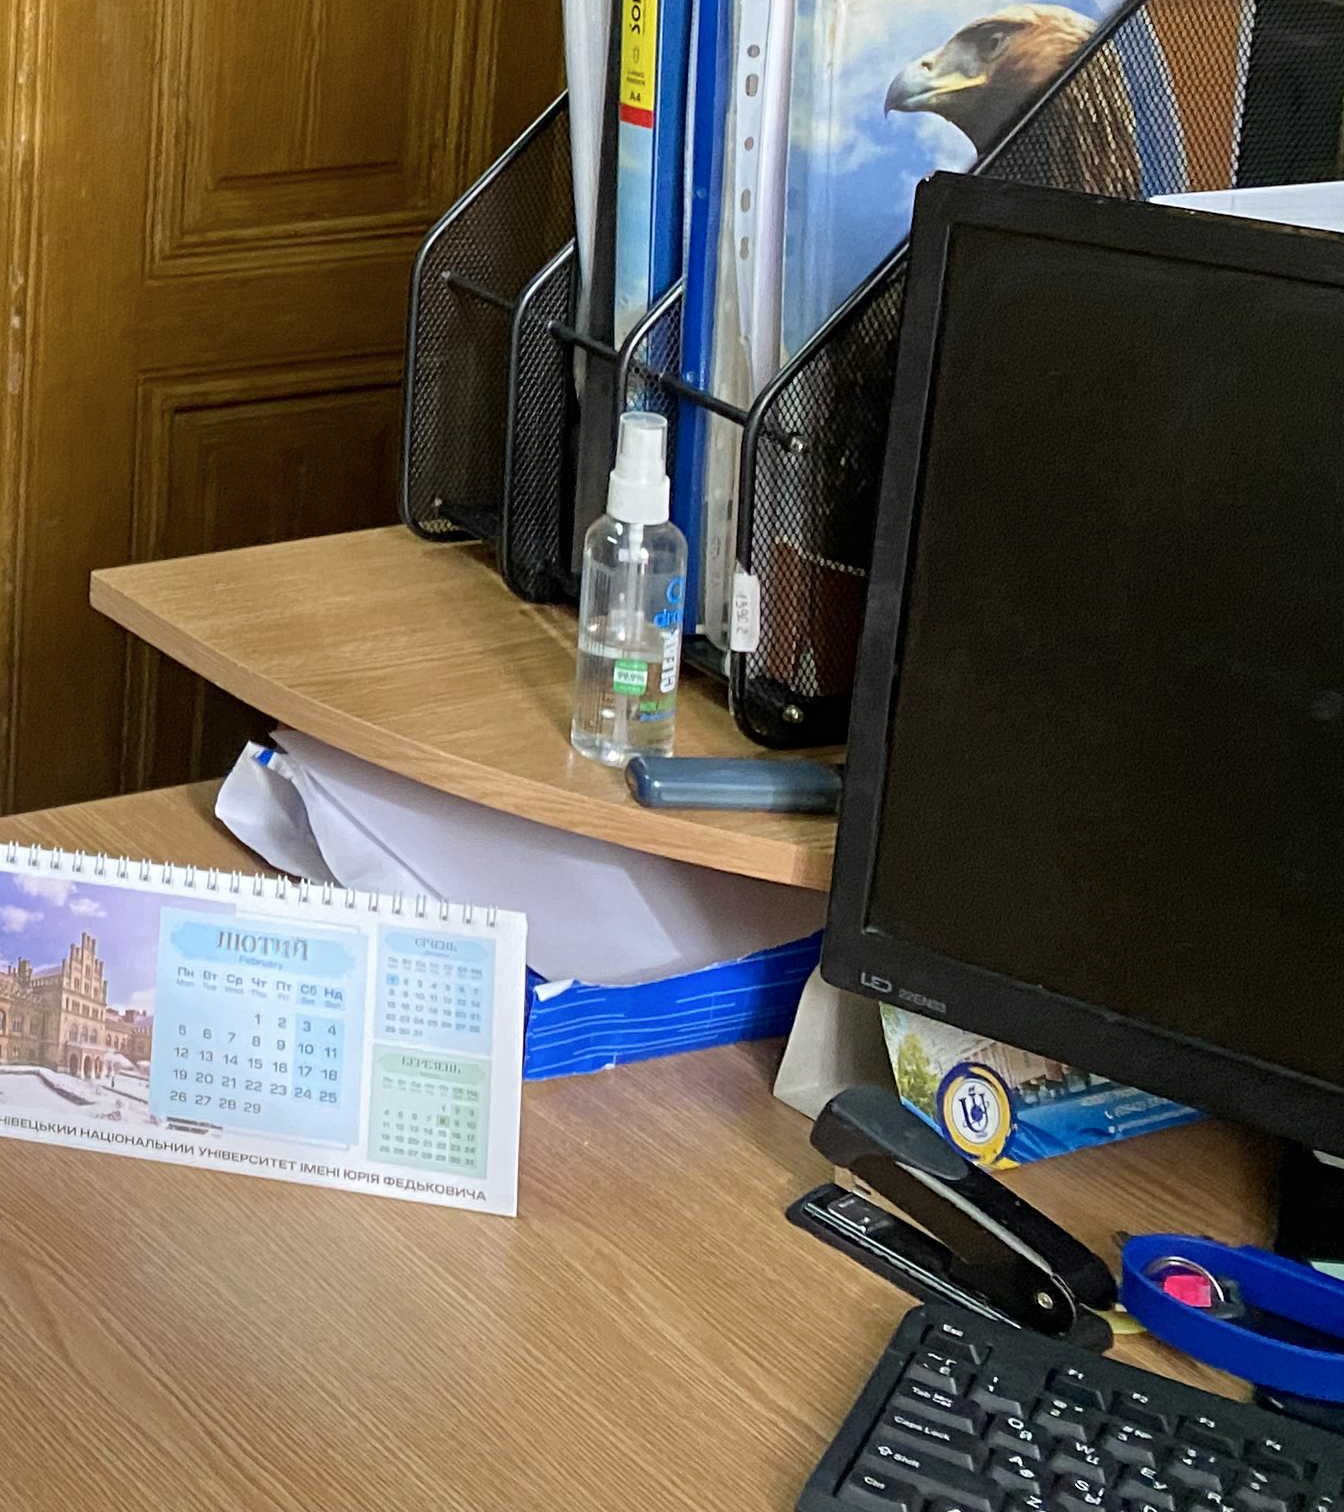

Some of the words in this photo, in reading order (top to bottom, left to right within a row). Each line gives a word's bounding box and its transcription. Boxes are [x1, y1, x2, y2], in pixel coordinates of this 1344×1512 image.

[203, 970, 218, 981] Вт
[226, 974, 243, 986] Ср
[251, 977, 267, 988] Чт
[276, 980, 292, 992] Пт
[300, 984, 318, 996] Сб
[324, 987, 344, 1001] Нд
[860, 971, 892, 994] LED
[254, 1013, 261, 1025] 1
[277, 1017, 287, 1028] 2
[302, 1021, 311, 1032] 3
[327, 1024, 337, 1036] 4
[178, 1025, 187, 1036] 5
[203, 1028, 212, 1039] 6
[227, 1032, 236, 1043] 7
[252, 1036, 261, 1047] 8
[276, 1040, 286, 1051] 9
[298, 1043, 314, 1055] 10
[324, 1047, 337, 1059] 11
[174, 1047, 189, 1059] 12
[199, 1051, 214, 1062] 13
[223, 1054, 238, 1065] 14
[247, 1058, 263, 1069] 15
[272, 1061, 288, 1073] 16
[298, 1065, 312, 1077] 17
[321, 1069, 338, 1081] 18
[172, 1069, 188, 1080] 19
[195, 1072, 214, 1084] 20
[221, 1076, 236, 1088] 21
[245, 1080, 262, 1092] 22
[270, 1083, 287, 1096] 23
[294, 1087, 312, 1100] 24
[319, 1091, 337, 1103] 25
[170, 1090, 187, 1102] 26
[194, 1095, 212, 1107] 27
[218, 1098, 236, 1110] 28
[243, 1102, 261, 1114] 29
[198, 1148, 297, 1171] УНІВЕРСИТЕТ
[300, 1163, 340, 1178] ІМЕНІ
[343, 1170, 380, 1184] ЮРІЯ
[383, 1175, 487, 1202] ФЕДЬКОВИЧА
[893, 1415, 924, 1432] Caps
[924, 1426, 950, 1441] Lock
[893, 1452, 921, 1469] Shift
